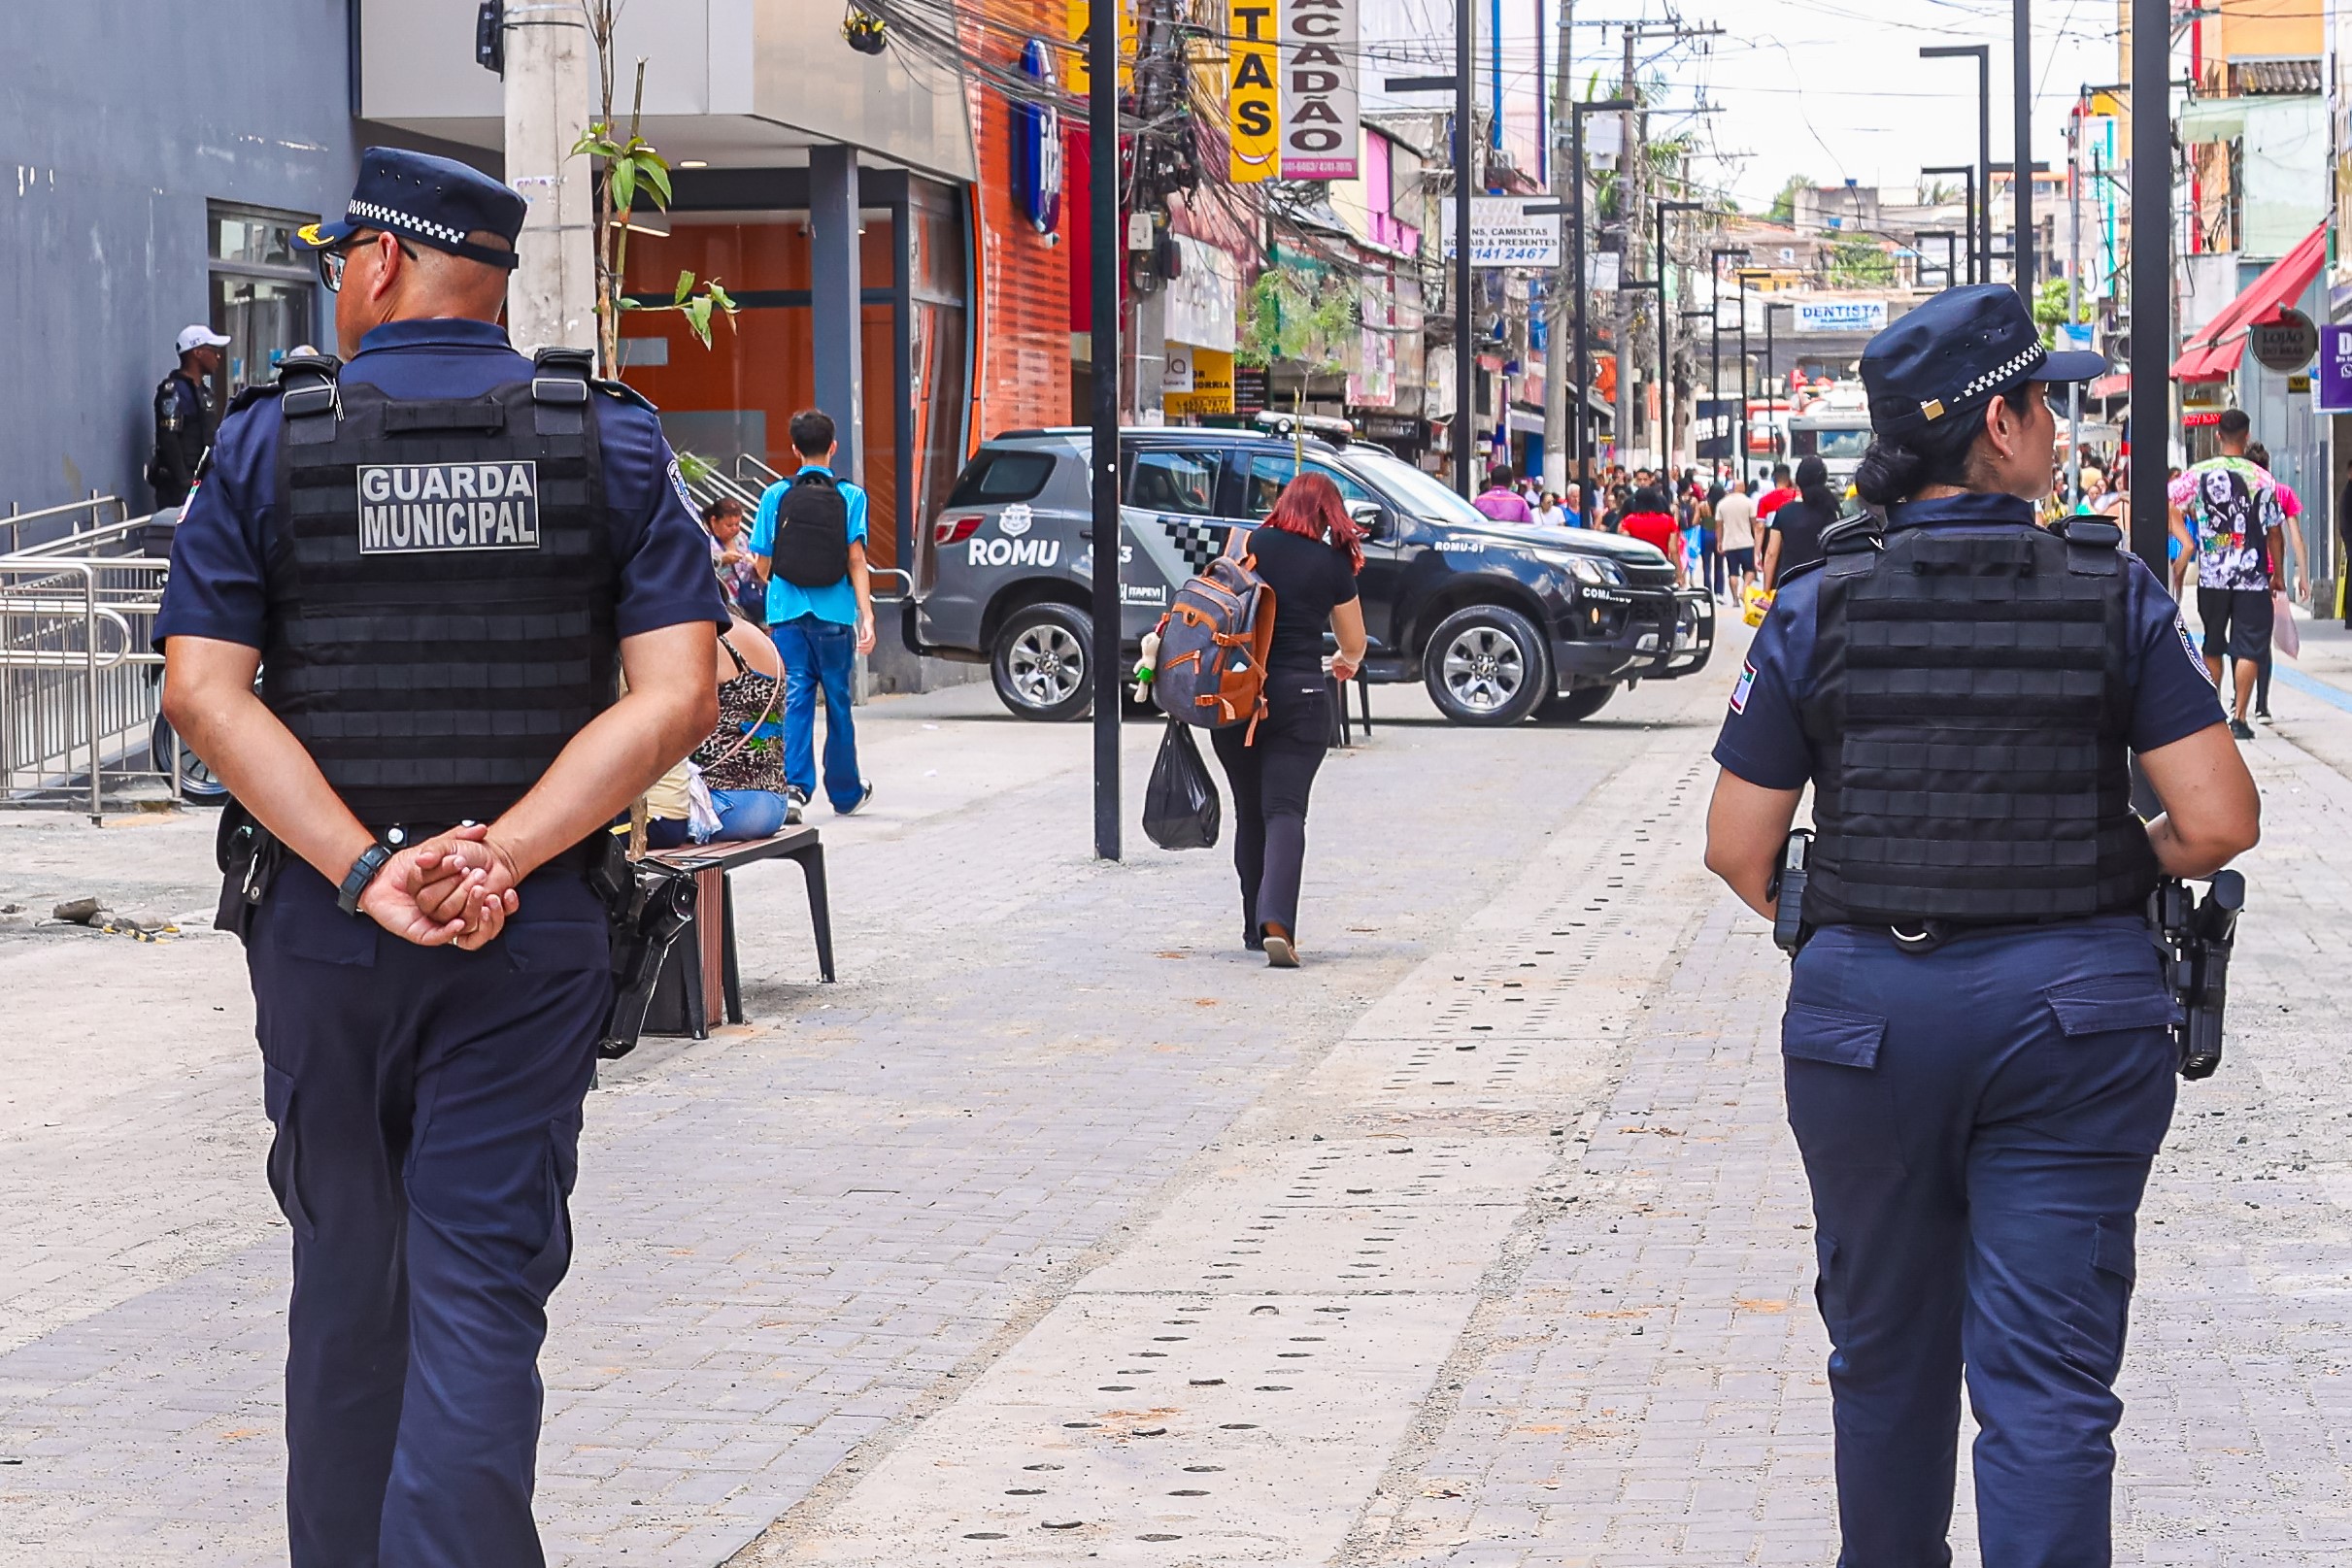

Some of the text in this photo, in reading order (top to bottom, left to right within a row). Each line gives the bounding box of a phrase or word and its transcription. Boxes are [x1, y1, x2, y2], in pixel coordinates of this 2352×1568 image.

[1803, 305, 1881, 317] DENTISTA
[362, 465, 533, 502] GUARDA
[364, 501, 535, 548] MUNICIPAL
[968, 538, 1060, 567] ROMU
[1434, 541, 1485, 553] ROMU-01
[1128, 586, 1161, 598] ITAPEVI
